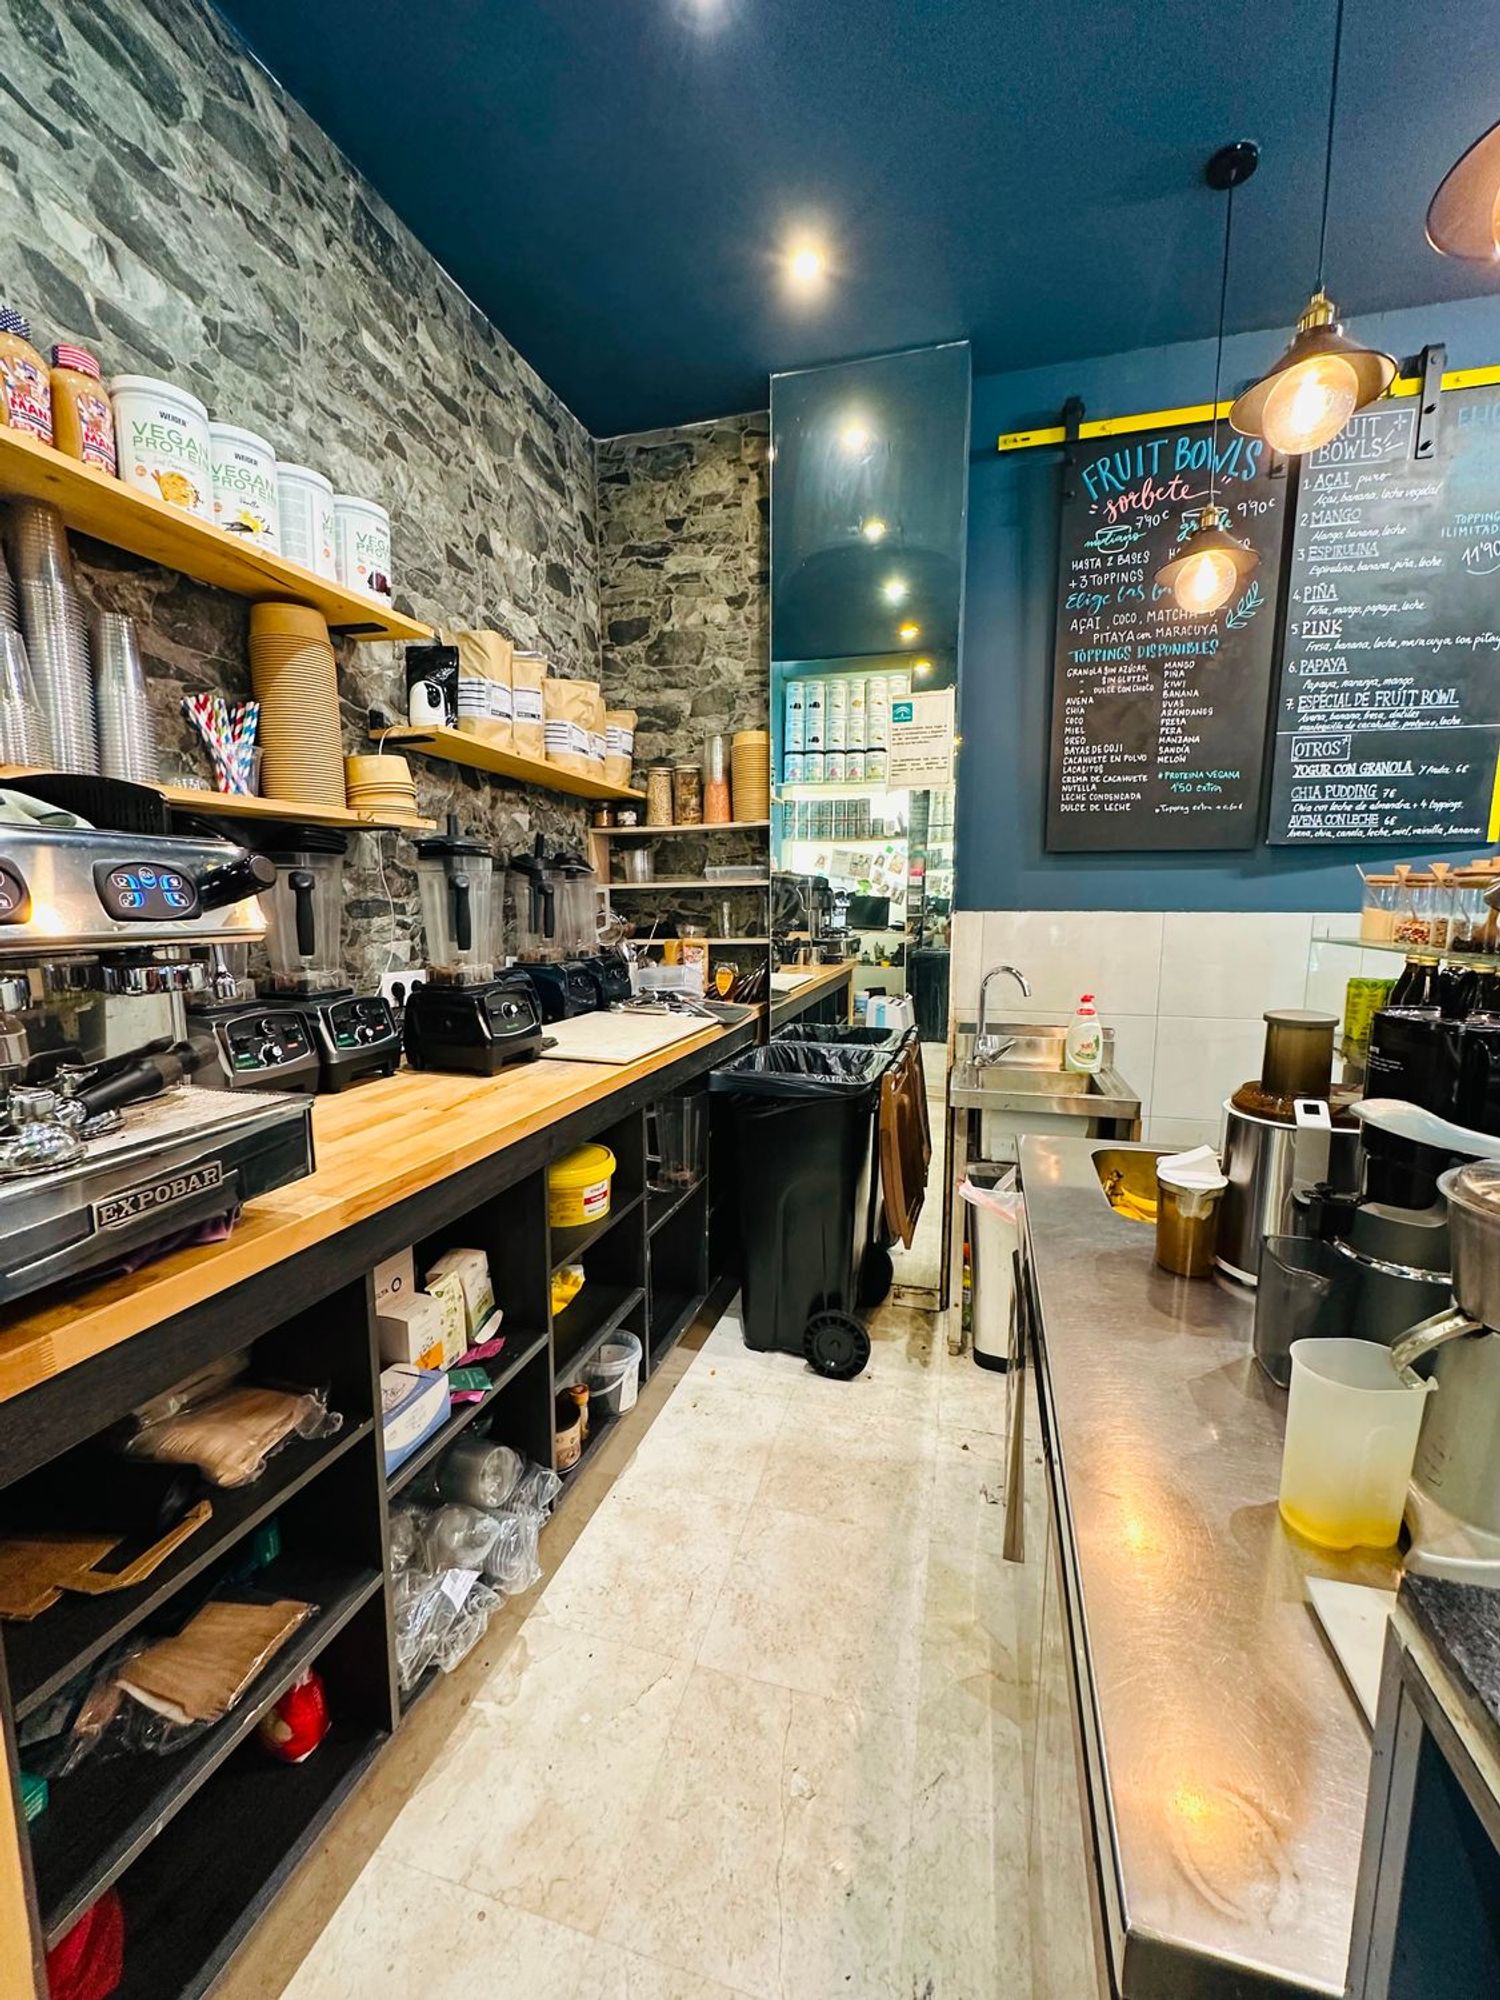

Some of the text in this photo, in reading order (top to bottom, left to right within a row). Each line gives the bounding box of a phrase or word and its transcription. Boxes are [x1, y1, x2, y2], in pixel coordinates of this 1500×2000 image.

[132, 420, 208, 460] VEGAN
[133, 435, 210, 472] PROTEIN
[1318, 438, 1384, 463] BOWLS
[1082, 436, 1263, 500] FRUIT BOWLS
[211, 463, 273, 493] VEGAN
[1355, 472, 1391, 491] puro
[1310, 508, 1361, 525] MANGO
[1308, 542, 1379, 560] ESPIRULINA
[1072, 558, 1101, 571] HASTA
[1117, 550, 1150, 566] BASES
[1090, 569, 1144, 587] TOPPINGS
[1304, 583, 1337, 601] PIÑA
[1065, 589, 1110, 613] Elige
[1302, 618, 1343, 636] PINK
[1094, 631, 1136, 645] PITAYA
[1136, 631, 1152, 641] con
[1455, 634, 1472, 645] con
[1068, 640, 1219, 663] TOPPINGS DISPONIBLES
[1067, 666, 1103, 678] GRANOLA
[1104, 665, 1117, 676] SIN
[1300, 657, 1348, 673] PAPAYA
[1102, 676, 1116, 685] SIN
[1163, 680, 1186, 689] KIWI
[1093, 685, 1116, 694] DULCE
[1117, 685, 1131, 694] CON
[1162, 690, 1199, 699] BANANA
[1065, 697, 1094, 705] AVENA
[1298, 692, 1352, 709] ESPECIAL
[1354, 691, 1370, 707] DE
[1374, 689, 1419, 707] FRUIT
[1420, 688, 1459, 706] BOWL
[1065, 717, 1084, 725] COCO
[1064, 726, 1086, 735] MIEL
[1160, 727, 1183, 735] PERA
[1158, 736, 1200, 745] MANZANA
[1064, 745, 1090, 756] BAYAS
[1091, 745, 1102, 755] DE
[1294, 740, 1341, 757] OTROS
[1110, 755, 1121, 763] EN
[1293, 763, 1331, 776] YOGUR
[1333, 762, 1357, 775] CON
[1359, 760, 1413, 775] GRANOLA
[1062, 775, 1088, 784] CREMA
[1062, 783, 1097, 792] NUTELLA
[1291, 785, 1322, 799] CHIA
[1325, 783, 1378, 799] PUDDING
[1061, 793, 1086, 801] LECHE
[1060, 803, 1131, 812] DULCE DE LECHE
[1355, 800, 1367, 811] de
[1288, 814, 1323, 827] AVENA
[1325, 813, 1346, 825] CON
[1346, 813, 1379, 824] LECHE
[99, 1167, 218, 1225] EXPOBAR
